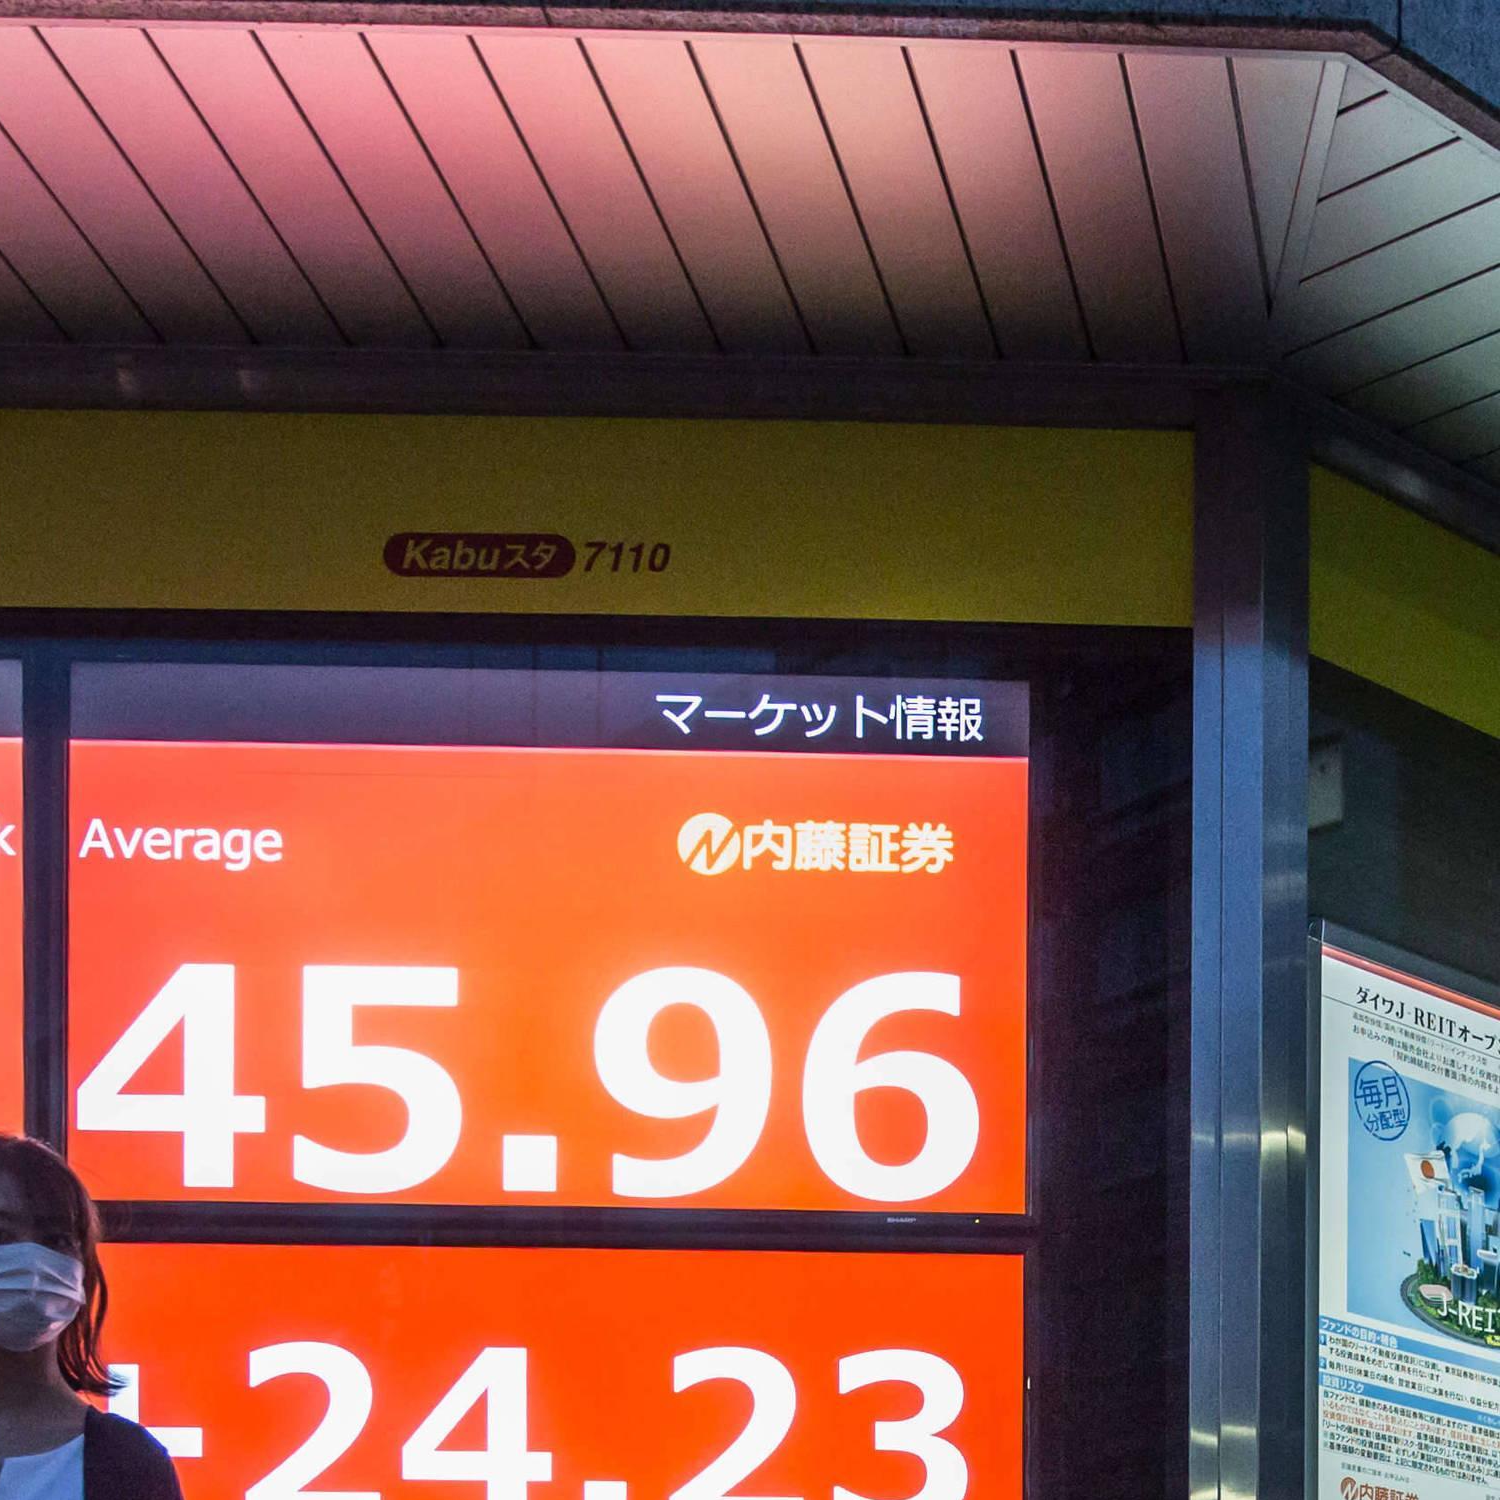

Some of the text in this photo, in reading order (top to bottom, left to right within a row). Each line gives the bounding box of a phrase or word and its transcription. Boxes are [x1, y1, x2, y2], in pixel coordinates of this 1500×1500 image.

[584, 541, 672, 573] 7110
[655, 694, 984, 742] マーケット情報
[79, 818, 284, 873] Average
[743, 819, 955, 874] 内藤証券
[1356, 986, 1500, 1056] ダイワJ-REITオープ
[1355, 1076, 1402, 1109] 毎月
[1364, 1107, 1408, 1133] 分配型
[1437, 1292, 1500, 1333] J-REI
